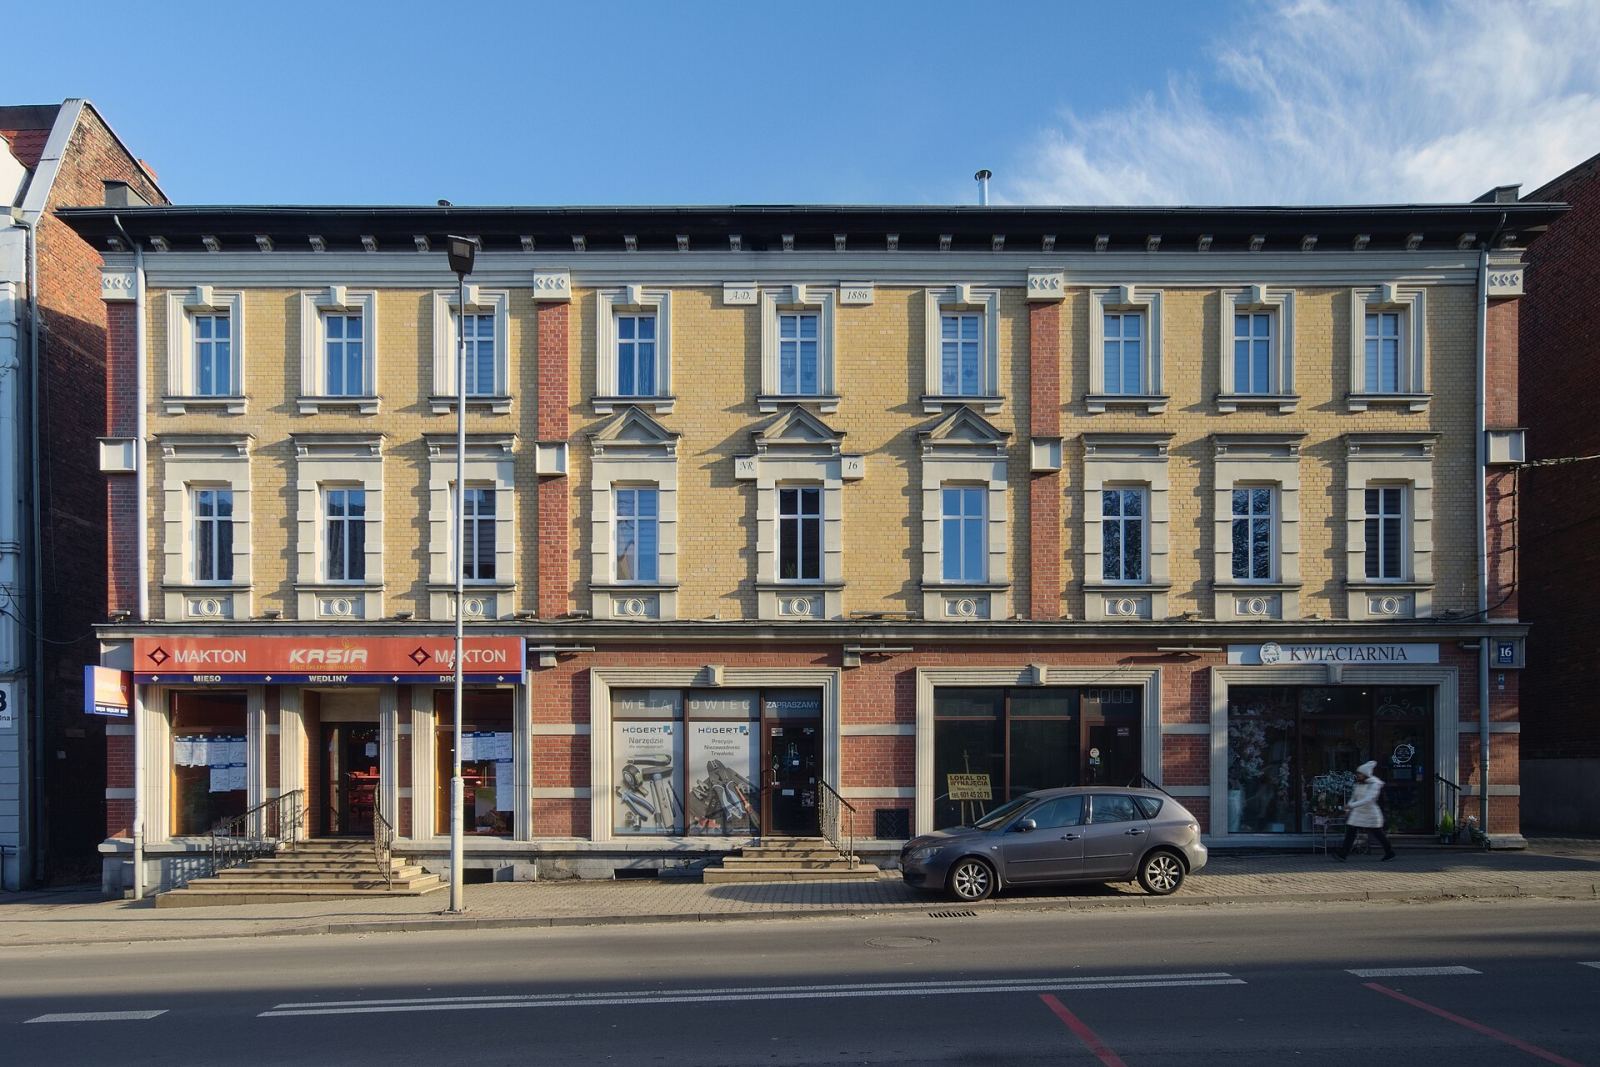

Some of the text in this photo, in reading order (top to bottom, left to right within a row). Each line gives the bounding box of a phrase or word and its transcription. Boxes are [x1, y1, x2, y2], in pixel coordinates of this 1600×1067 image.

[847, 291, 868, 300] 1886
[848, 461, 858, 470] 16
[174, 649, 247, 663] MAKTON
[289, 649, 368, 664] KASIA
[1289, 646, 1408, 661] KWIACIARNIA
[1500, 647, 1512, 657] 16
[766, 701, 819, 709] ZAPRASZAMY
